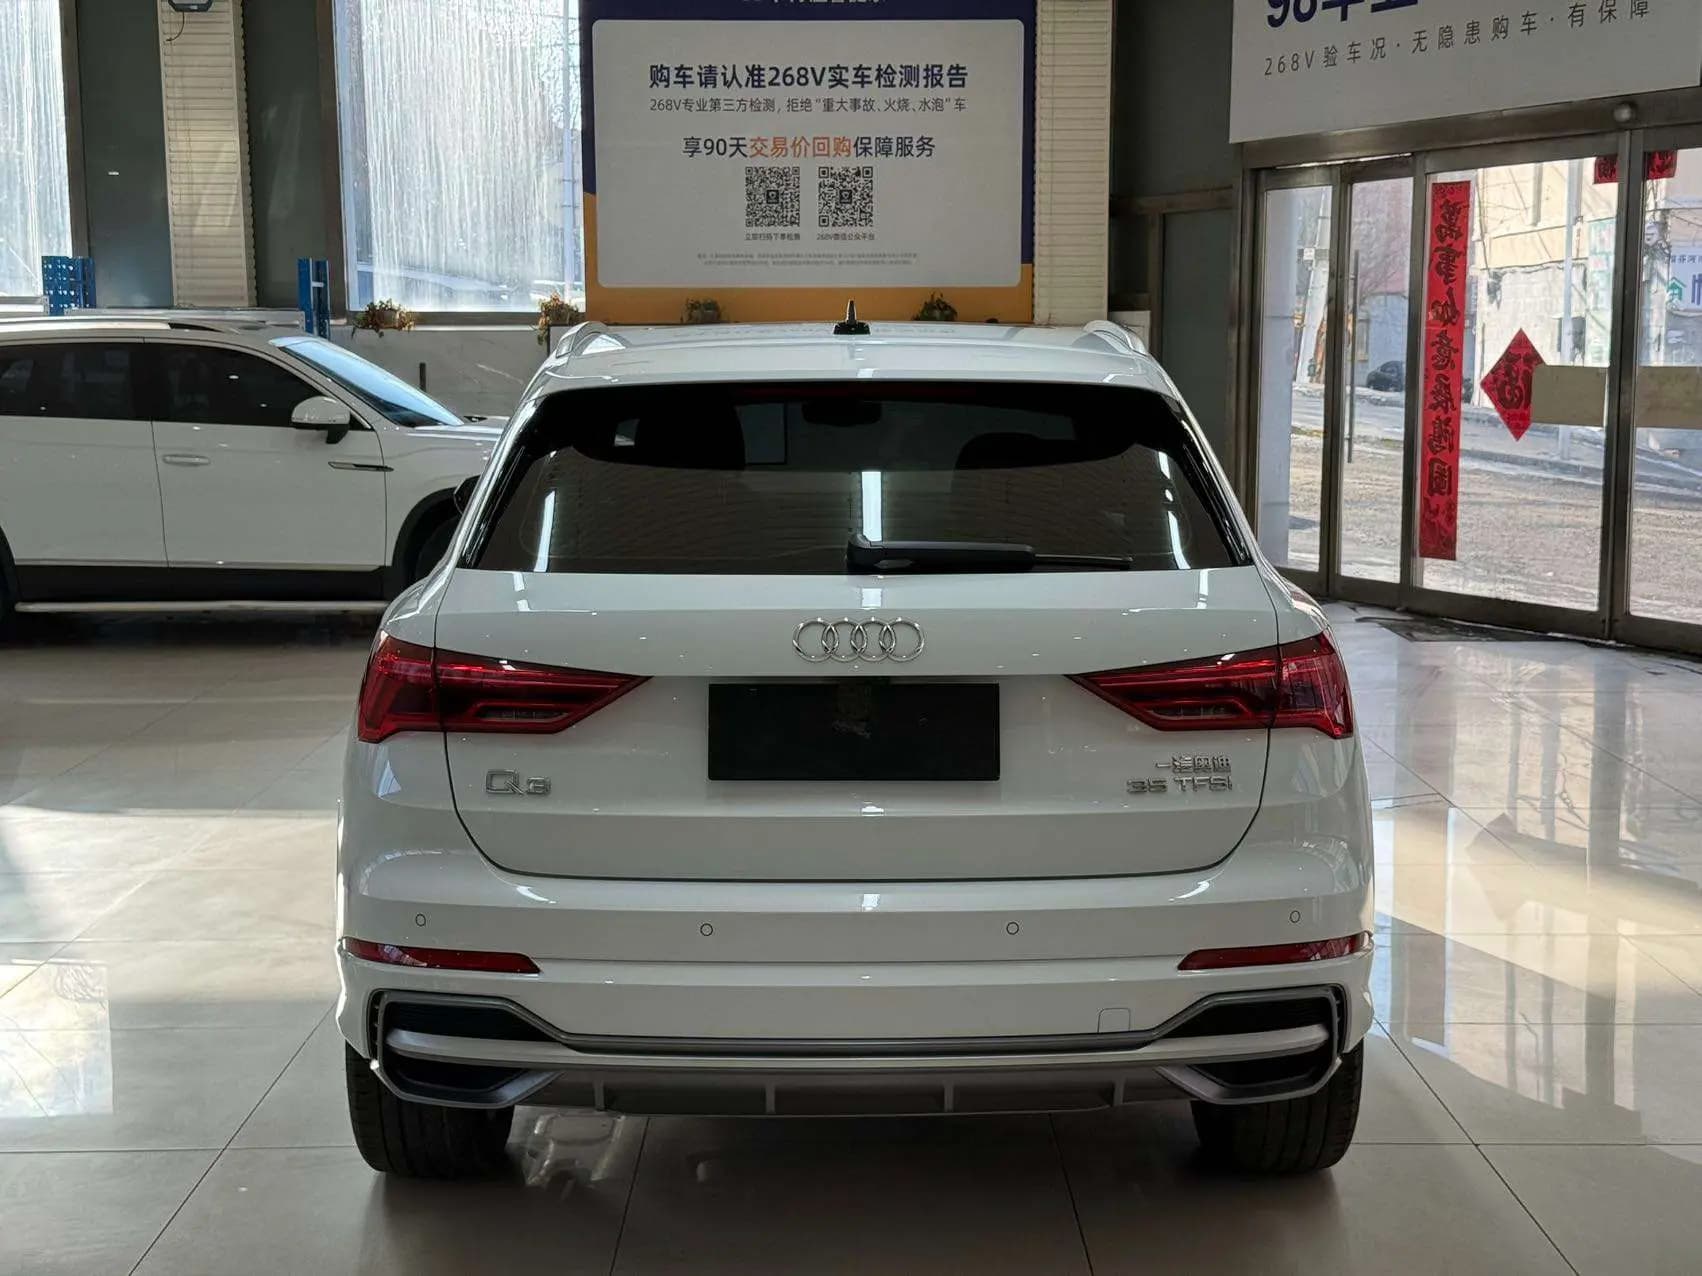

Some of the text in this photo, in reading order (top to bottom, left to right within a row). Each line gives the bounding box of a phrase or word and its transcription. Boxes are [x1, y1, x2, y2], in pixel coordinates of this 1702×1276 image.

[649, 64, 968, 89] 购车请认准268V实车检测报告
[683, 136, 936, 158] 享90天交易价回购保障服务
[1127, 779, 1167, 793] 35
